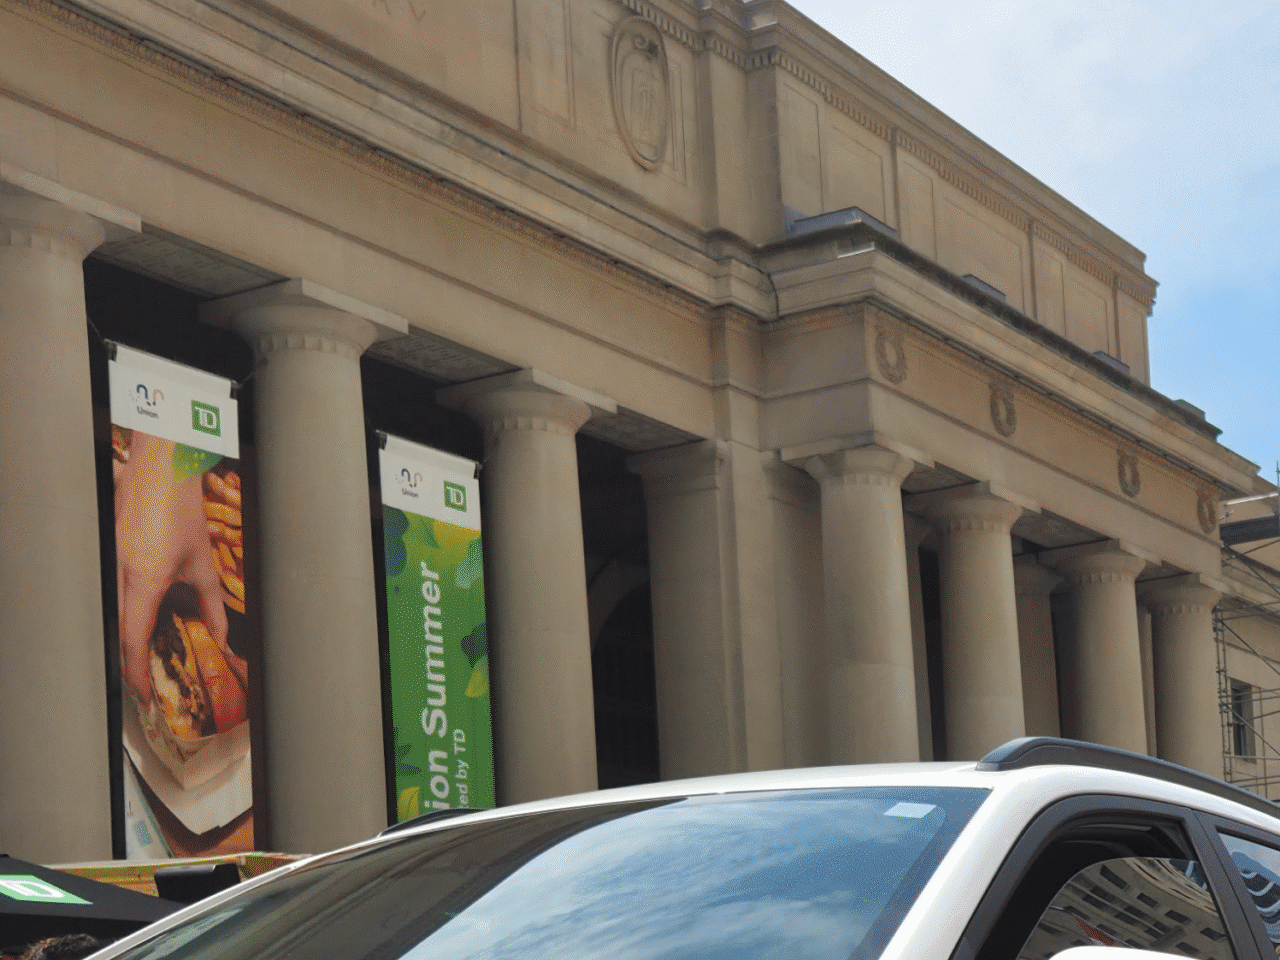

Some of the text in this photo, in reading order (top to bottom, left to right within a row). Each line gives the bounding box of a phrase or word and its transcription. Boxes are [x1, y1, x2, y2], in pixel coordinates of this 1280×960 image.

[136, 406, 159, 418] Union
[194, 406, 218, 429] TD
[402, 488, 419, 499] Union
[446, 486, 464, 506] TD
[421, 560, 447, 738] Summer
[452, 728, 469, 808] ed by TD
